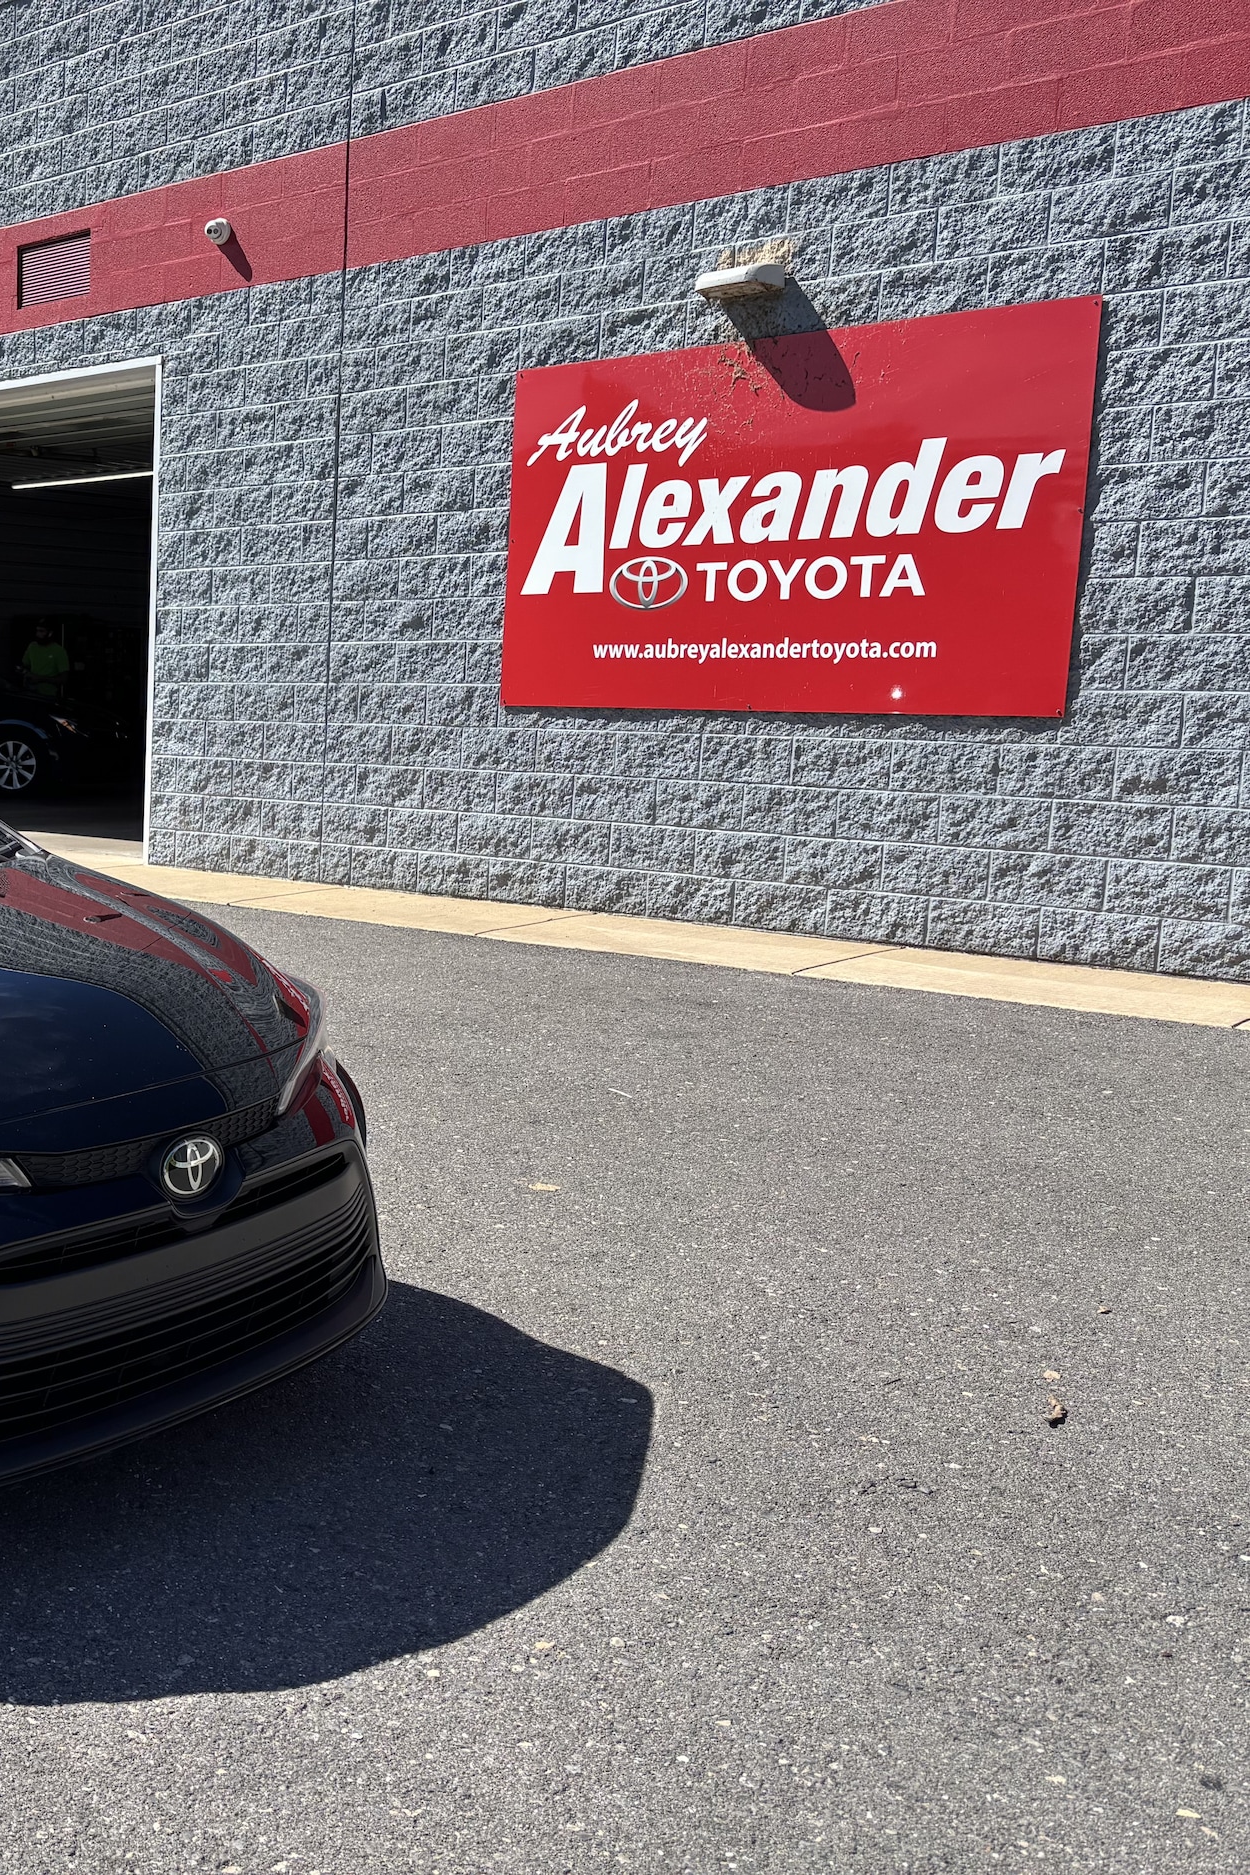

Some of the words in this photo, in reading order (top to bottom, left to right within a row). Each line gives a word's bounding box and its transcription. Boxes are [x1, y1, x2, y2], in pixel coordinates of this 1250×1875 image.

[526, 398, 708, 467] Aubrey
[520, 436, 1067, 596] Alexander
[696, 553, 926, 602] TOYOTA
[592, 636, 937, 665] www.aubreyalexandertoyota.com
